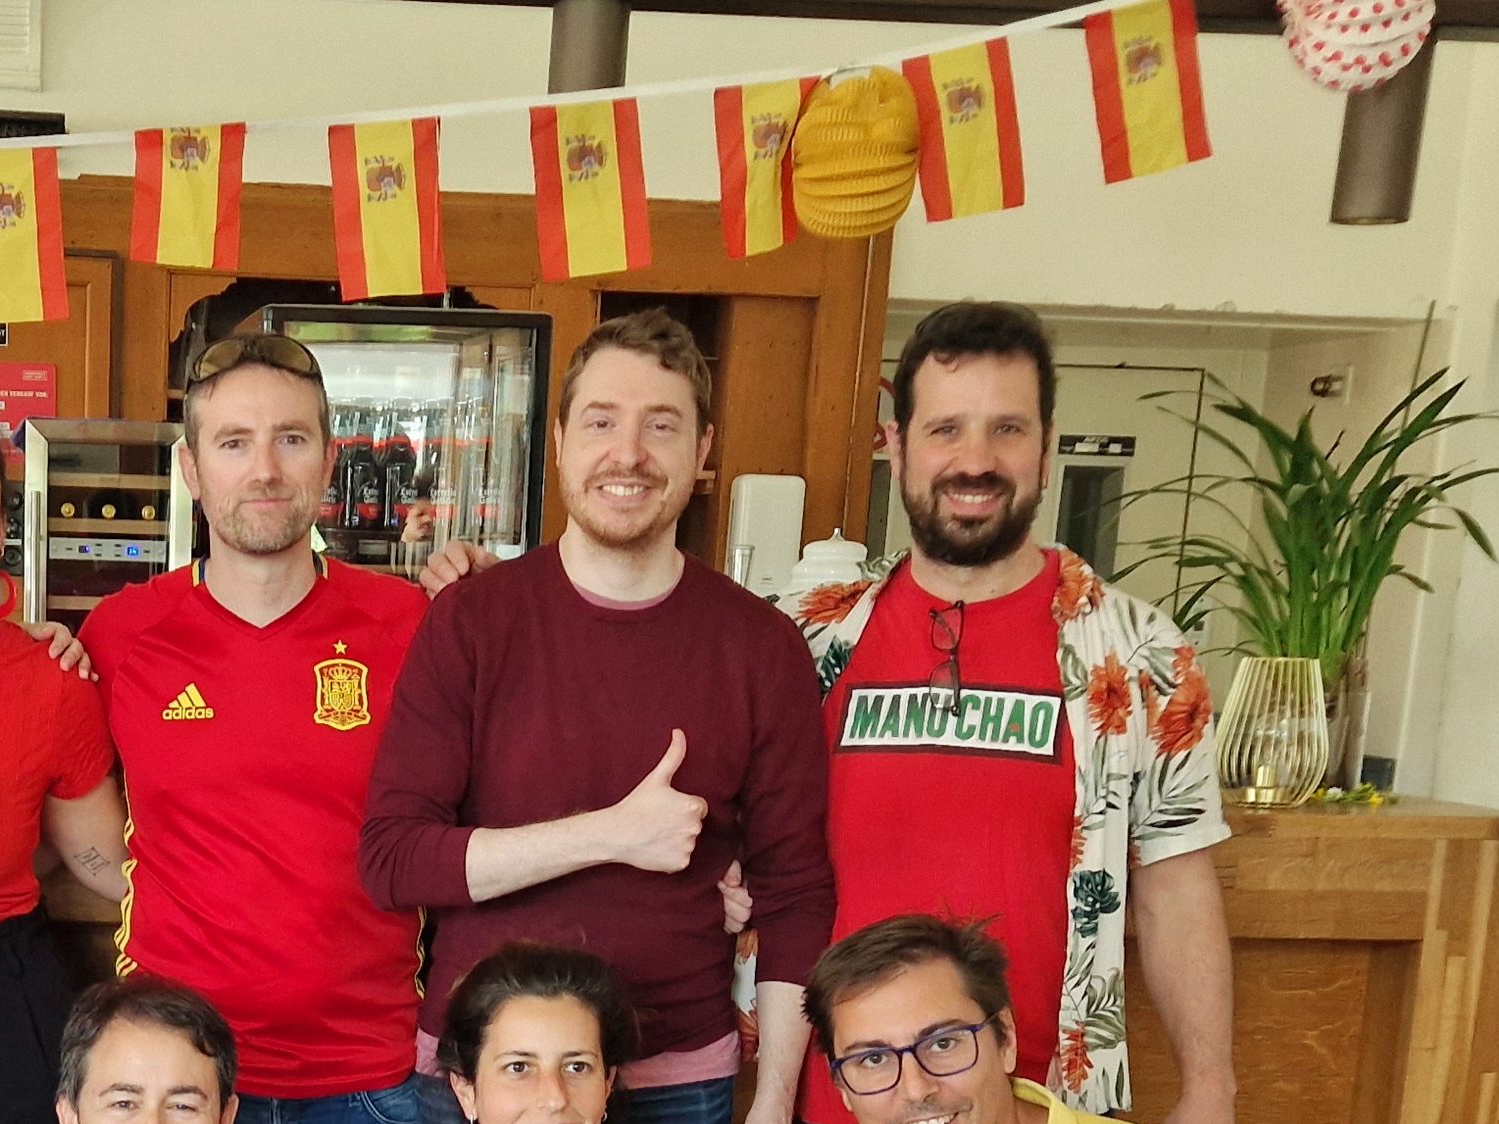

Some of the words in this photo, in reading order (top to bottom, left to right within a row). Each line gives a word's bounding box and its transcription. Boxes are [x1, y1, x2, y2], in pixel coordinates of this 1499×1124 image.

[162, 706, 214, 720] adidas
[849, 692, 952, 739] MANU
[953, 693, 1054, 749] CHAO
